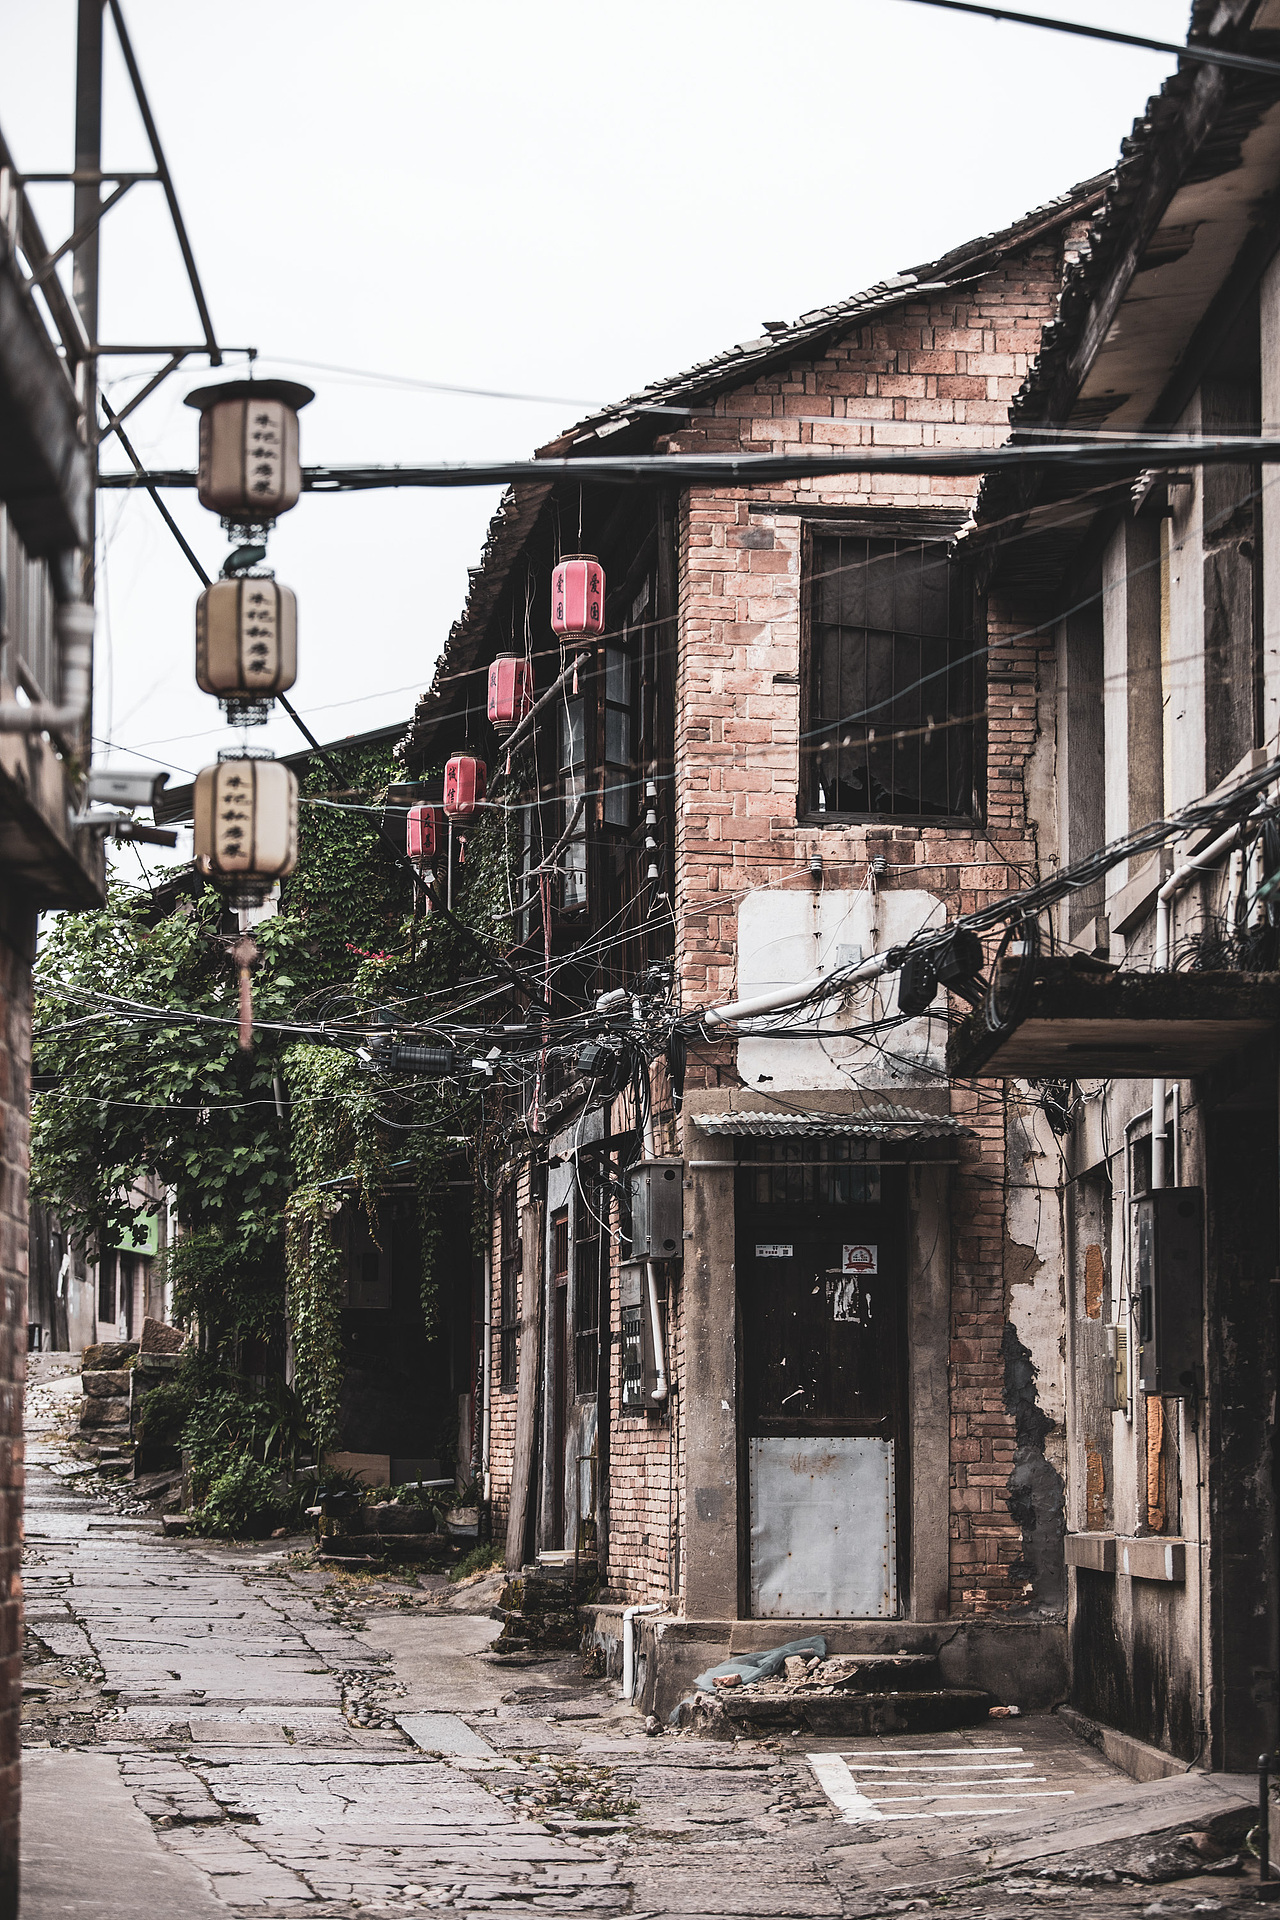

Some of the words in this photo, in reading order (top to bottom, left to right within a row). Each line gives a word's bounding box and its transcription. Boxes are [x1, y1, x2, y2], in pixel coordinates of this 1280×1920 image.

[557, 573, 564, 620] 爱国
[590, 573, 600, 621] 爱国
[448, 766, 457, 803] 诚信
[424, 813, 433, 848] 友善
